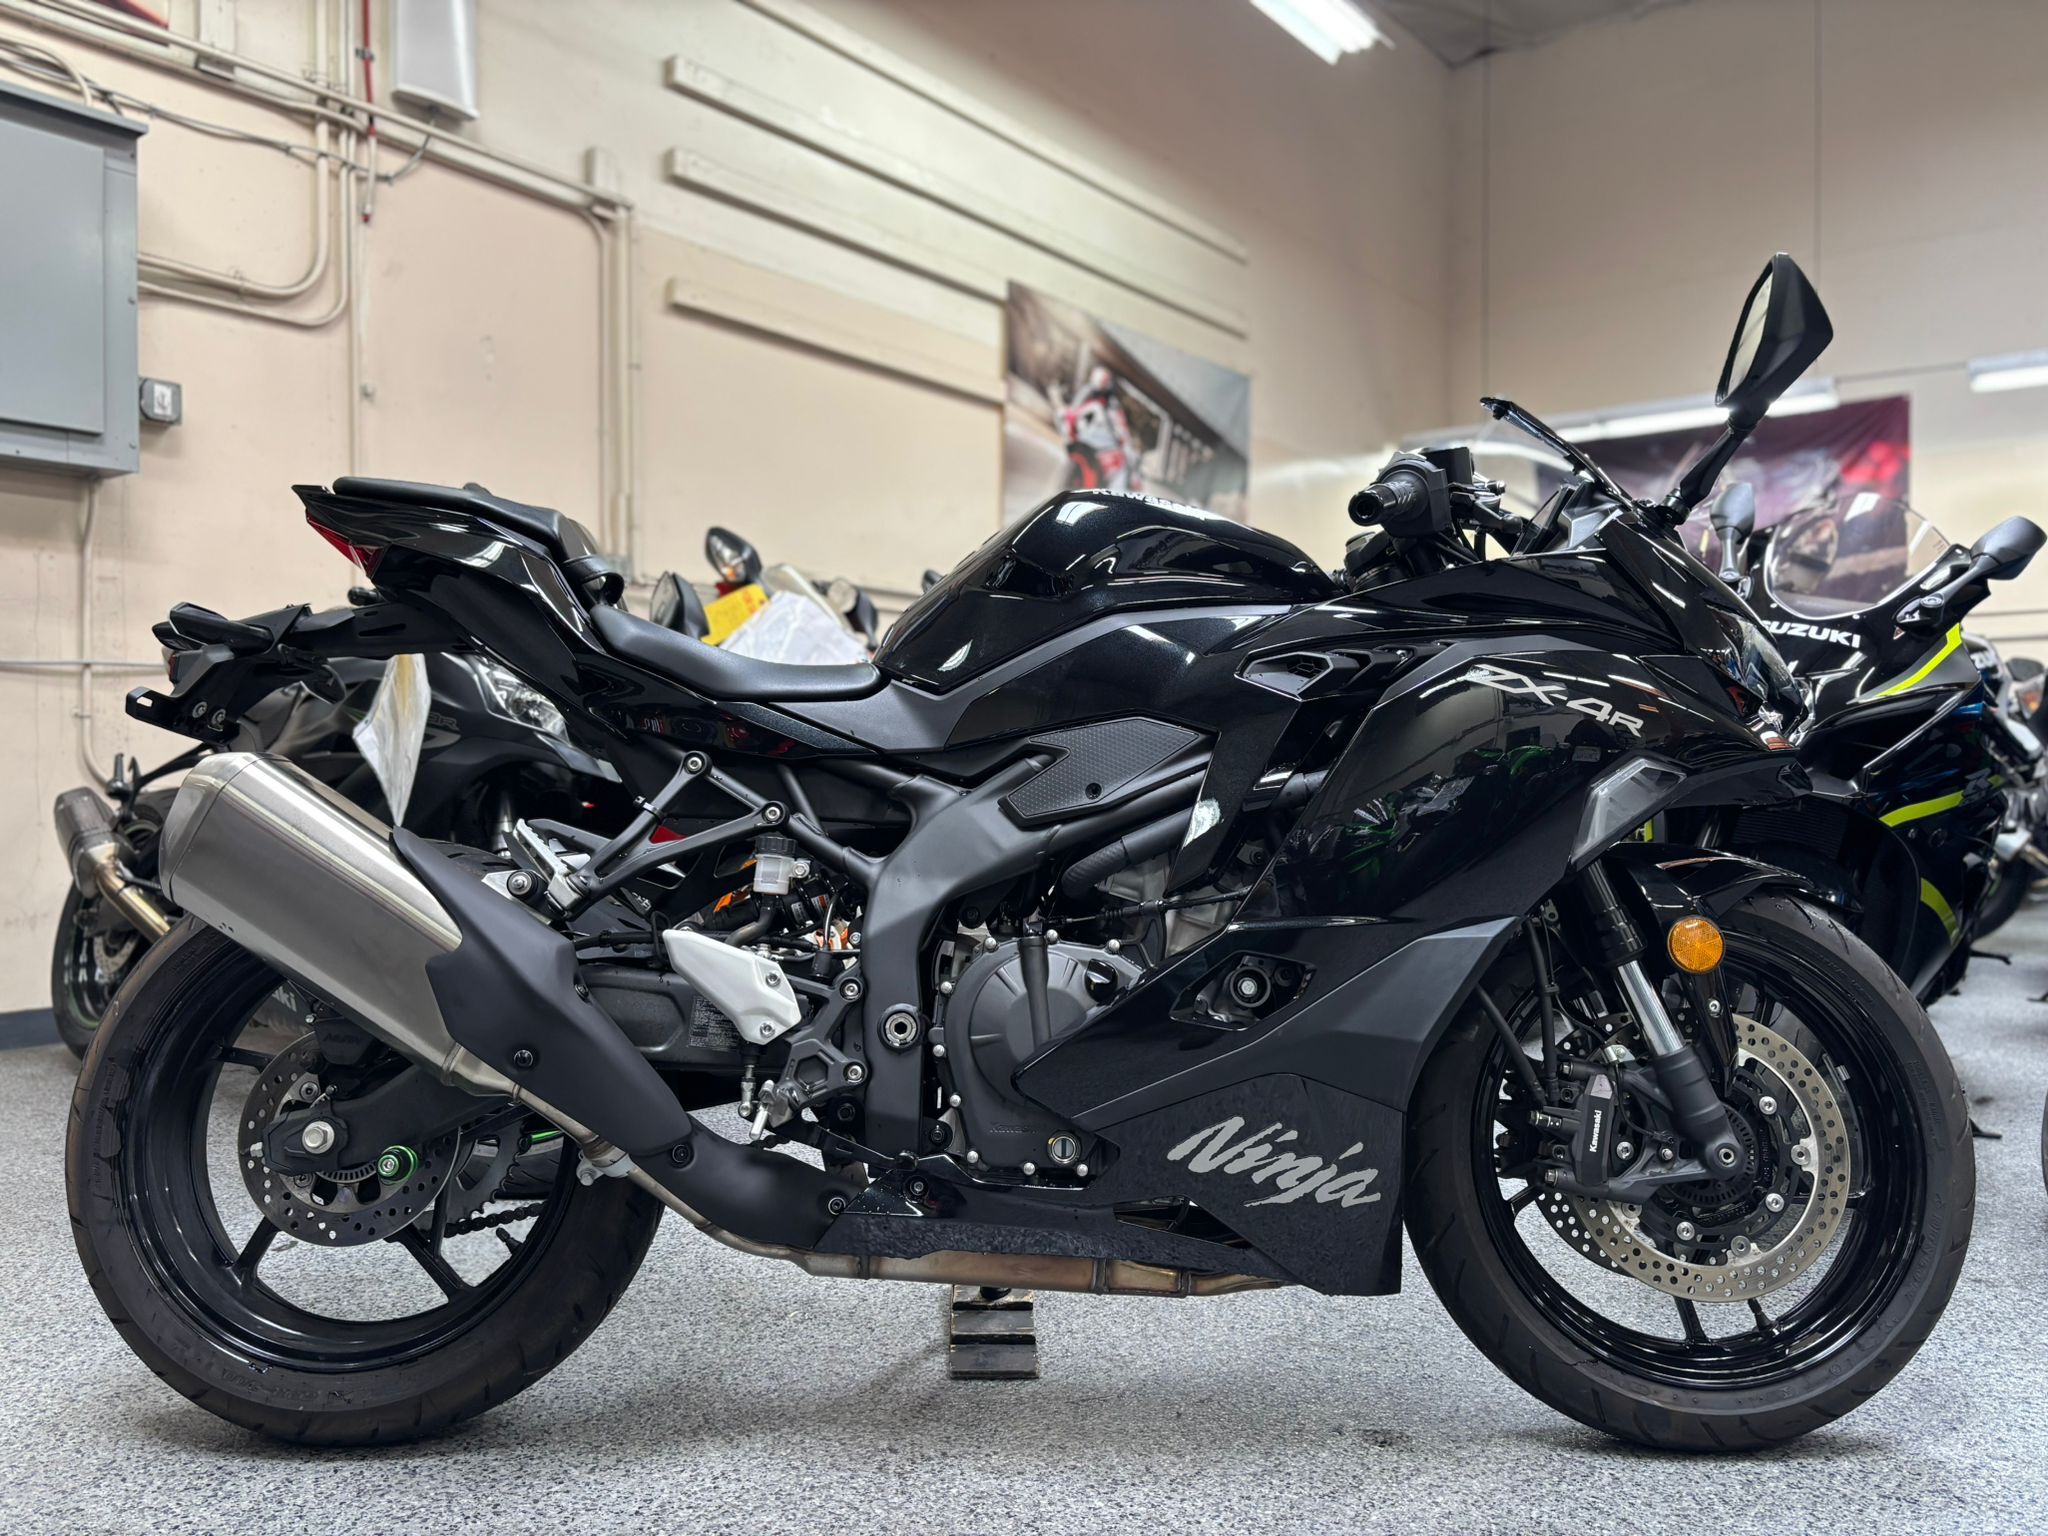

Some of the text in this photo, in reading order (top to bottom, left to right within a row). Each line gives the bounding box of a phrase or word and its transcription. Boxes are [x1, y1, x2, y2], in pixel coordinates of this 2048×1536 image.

[1466, 663, 1645, 738] ZX-4R
[1166, 1116, 1382, 1208] Ninja
[1589, 1109, 1603, 1153] Kawasaki
